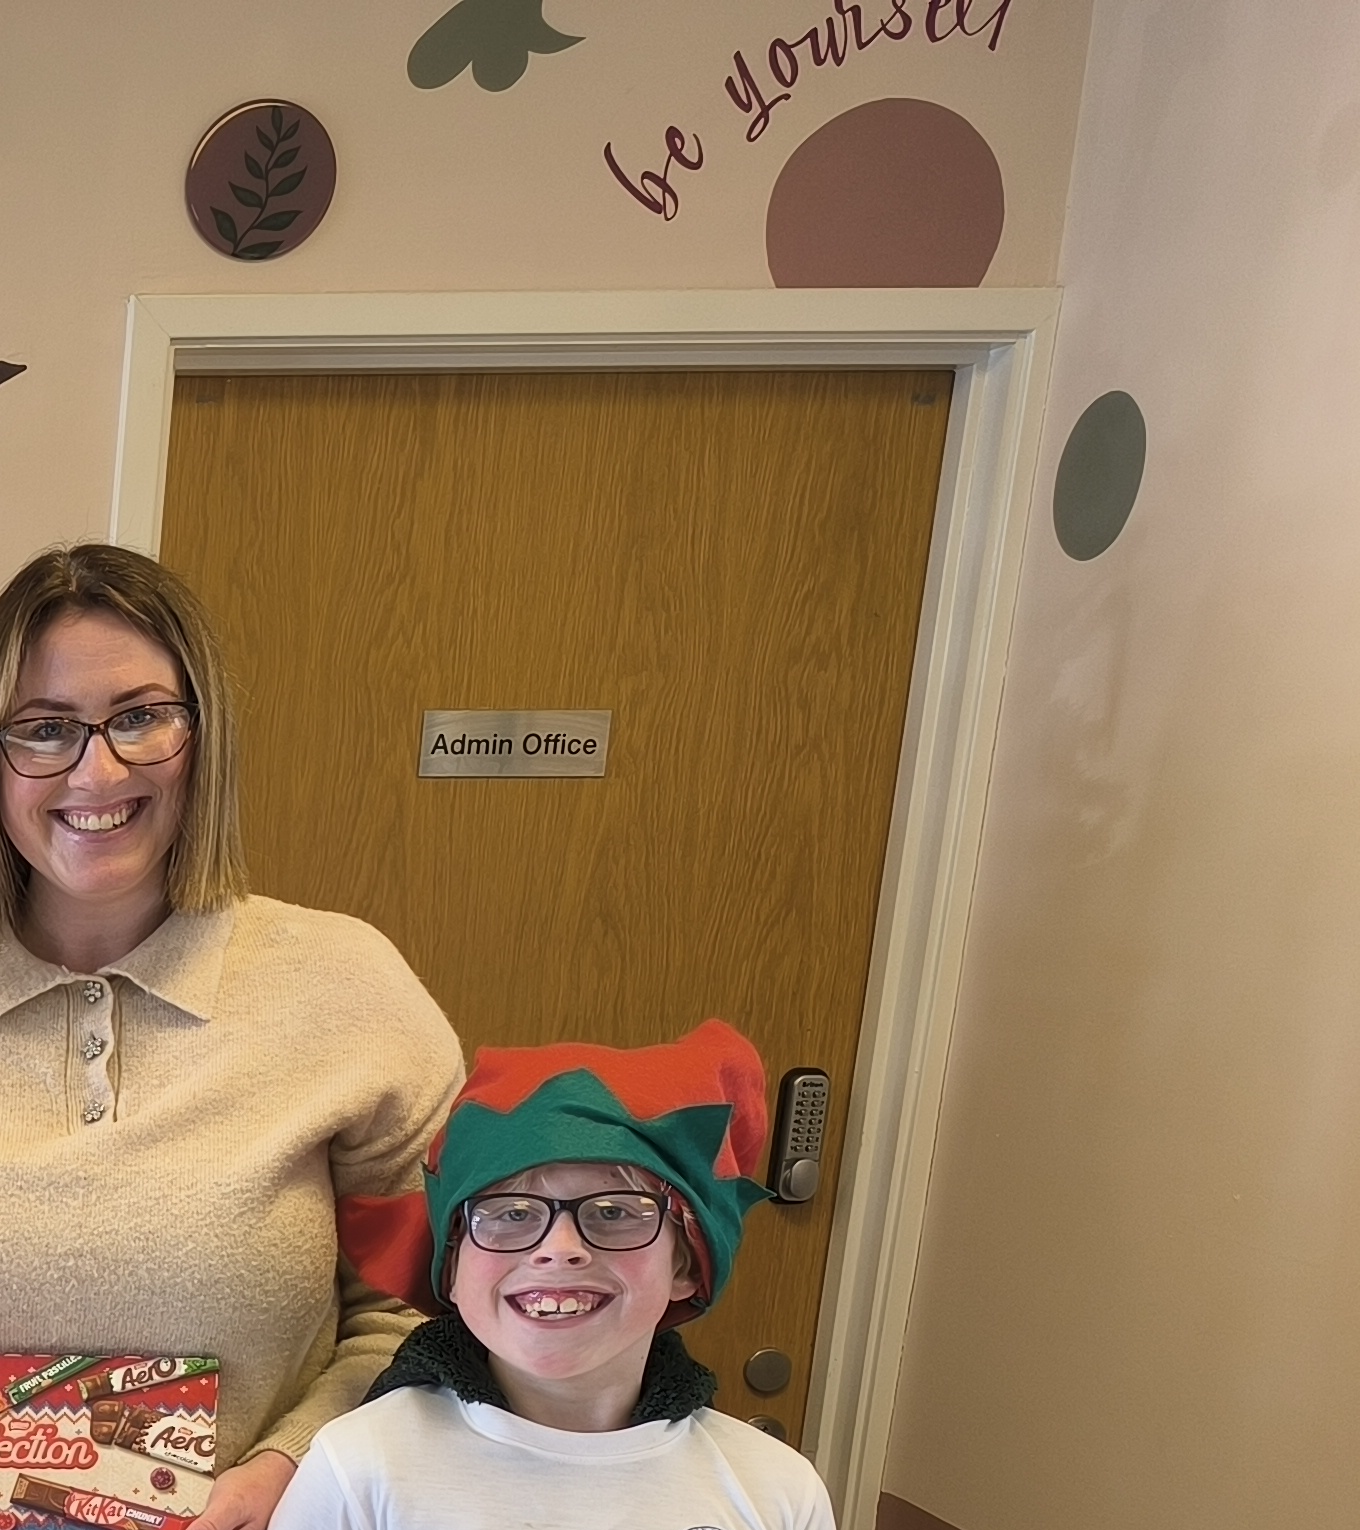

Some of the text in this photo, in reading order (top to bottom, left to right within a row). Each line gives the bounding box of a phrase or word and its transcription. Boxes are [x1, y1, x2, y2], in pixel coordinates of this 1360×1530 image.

[603, 125, 704, 221] be
[430, 733, 599, 755] Admin Office
[74, 1495, 163, 1525] KitKat CHUNKY
